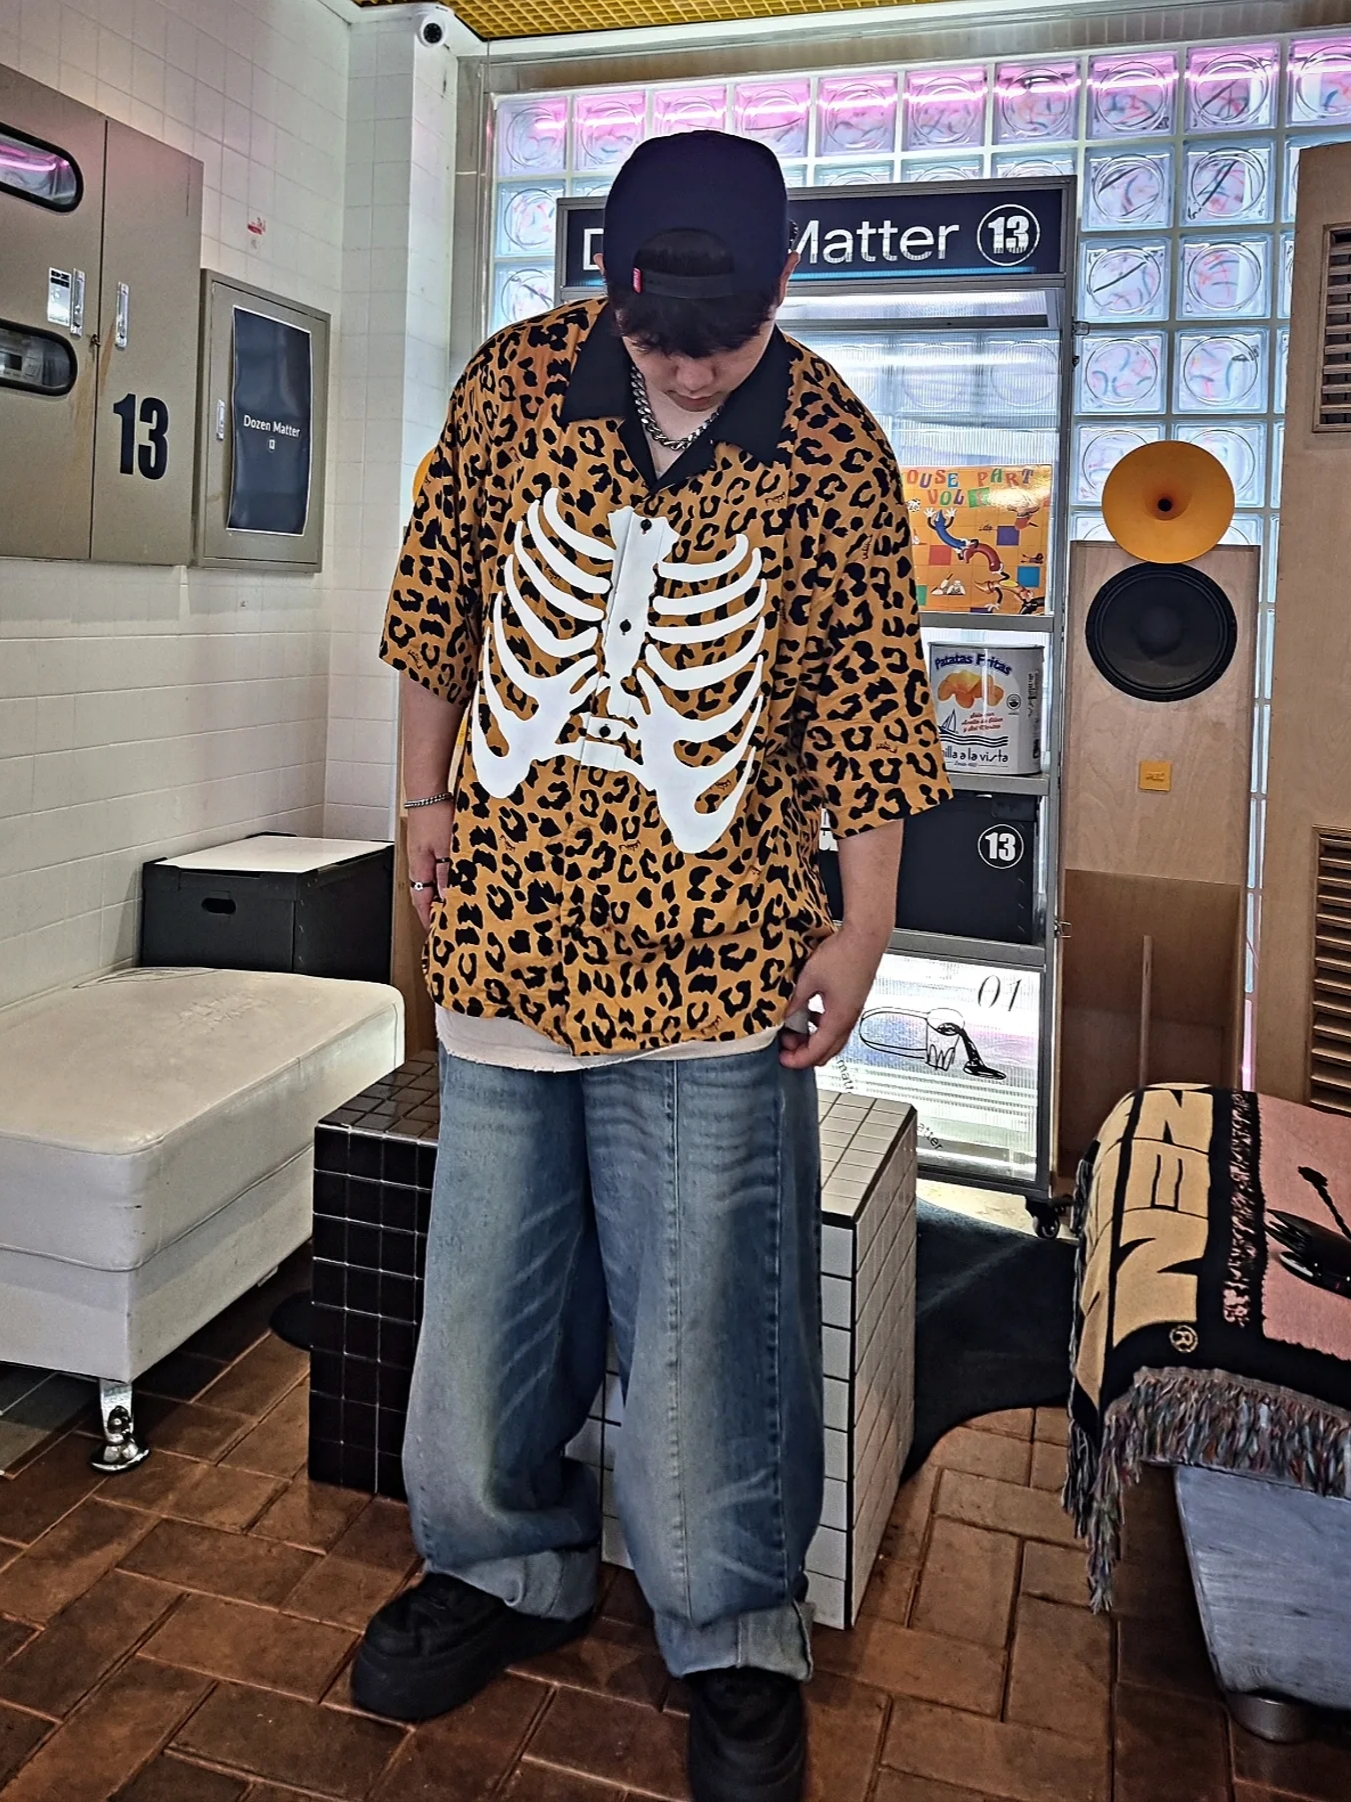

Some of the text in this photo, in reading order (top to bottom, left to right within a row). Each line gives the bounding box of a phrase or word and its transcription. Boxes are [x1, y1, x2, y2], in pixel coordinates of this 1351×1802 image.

[988, 215, 1030, 254] 13
[113, 393, 169, 480] 13
[243, 414, 301, 438] Dozen Matter
[906, 469, 959, 488] OUSE
[935, 653, 1012, 676] Patatas Fritas
[985, 831, 1016, 862] 13
